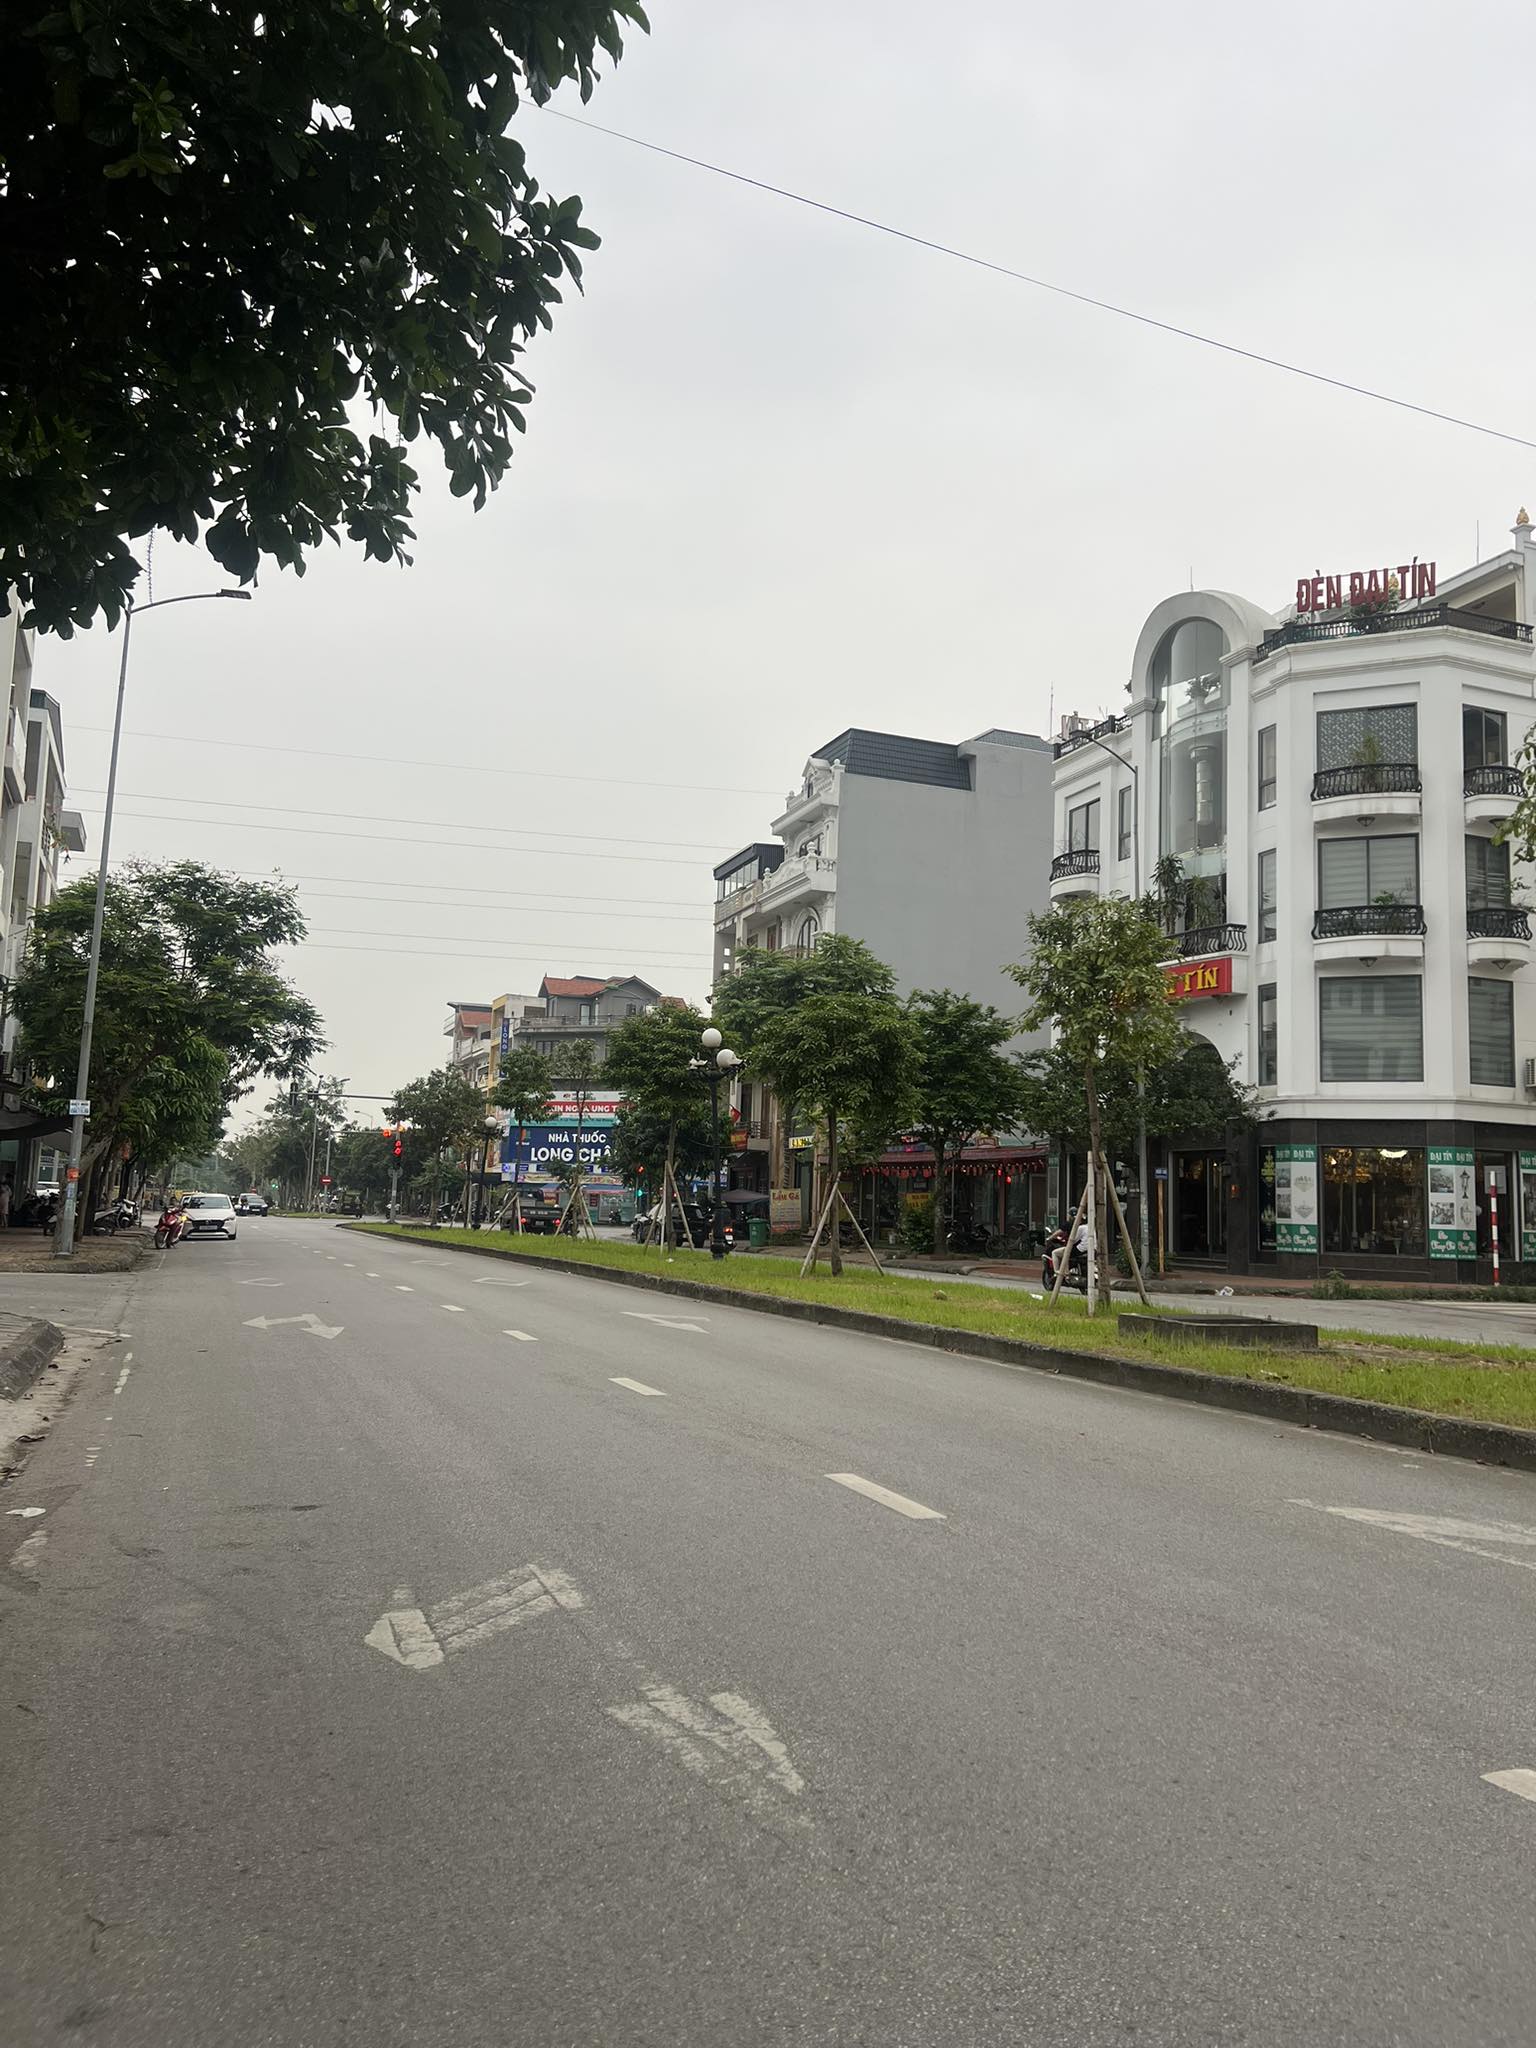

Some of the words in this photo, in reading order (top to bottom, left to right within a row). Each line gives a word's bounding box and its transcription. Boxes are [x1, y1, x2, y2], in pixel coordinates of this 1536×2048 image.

[1296, 569, 1342, 613] ĐÈN
[1350, 568, 1389, 612] ĐẠI
[1397, 556, 1436, 600] TÍN
[1184, 963, 1219, 991] TÍN
[548, 1131, 569, 1143] NHÀ
[573, 1130, 607, 1143] THUỐC
[531, 1147, 574, 1162] LONG
